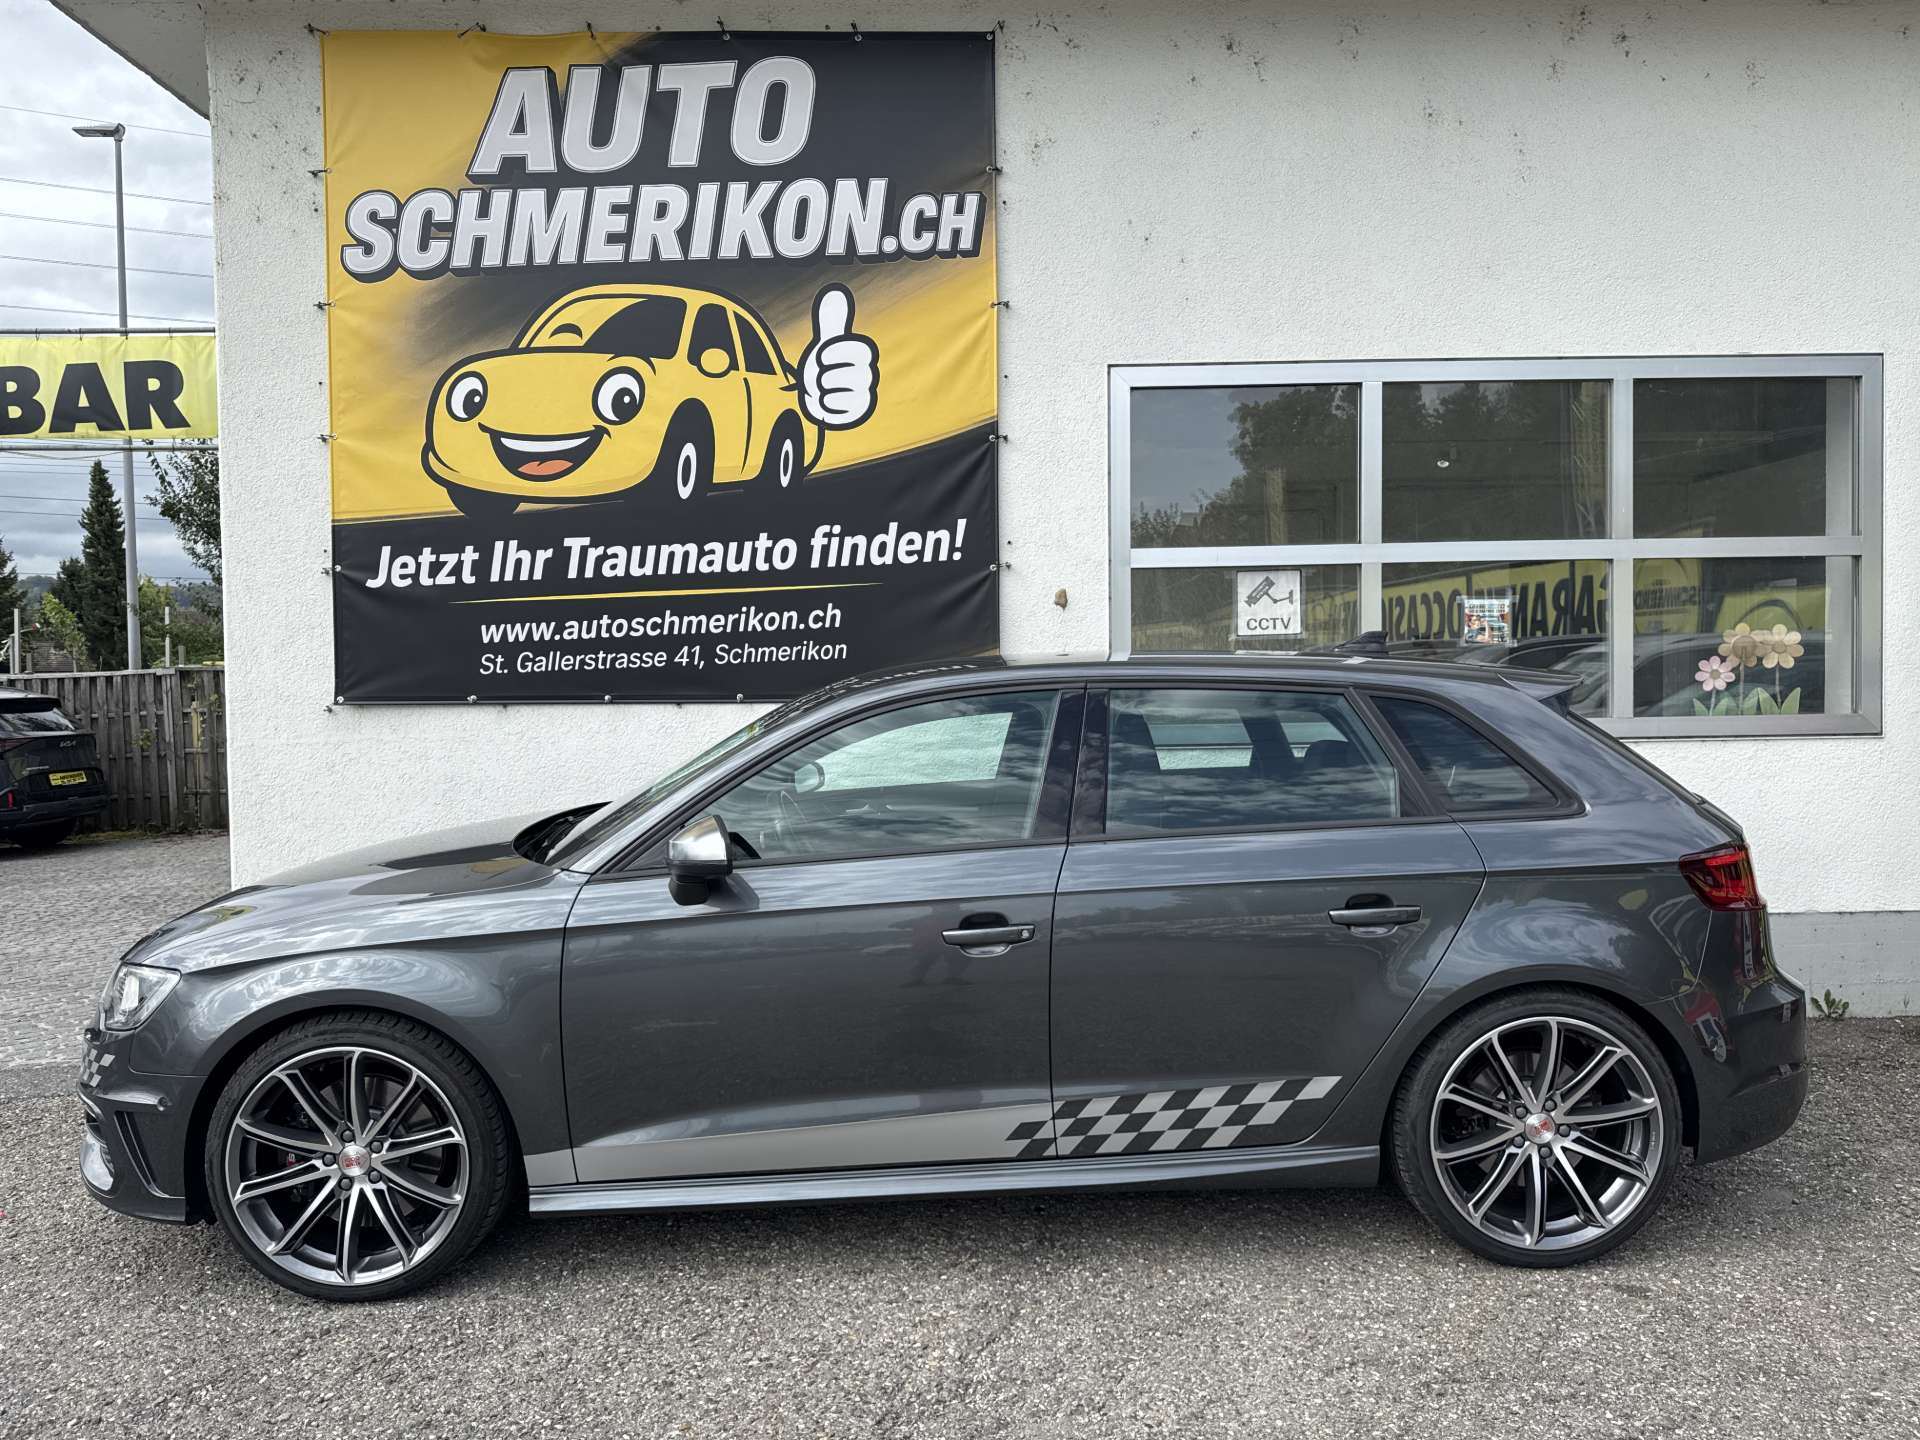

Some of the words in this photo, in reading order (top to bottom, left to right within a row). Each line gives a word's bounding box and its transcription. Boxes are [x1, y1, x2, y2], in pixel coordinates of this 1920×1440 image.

[467, 57, 816, 175] AUTO
[341, 177, 982, 275] SCHMERIKON.CH
[0, 359, 192, 436] BAR
[365, 545, 480, 589] Jetzt
[489, 539, 554, 583] Ihr
[563, 532, 798, 579] Traumauto
[810, 518, 968, 569] finden!
[479, 653, 509, 675] St.
[516, 649, 667, 674] Gallerstrasse
[673, 645, 705, 671] 41,
[714, 640, 848, 666] Schmerikon
[480, 602, 842, 644] www.autoschmerikon.ch
[1246, 617, 1291, 631] CCTV
